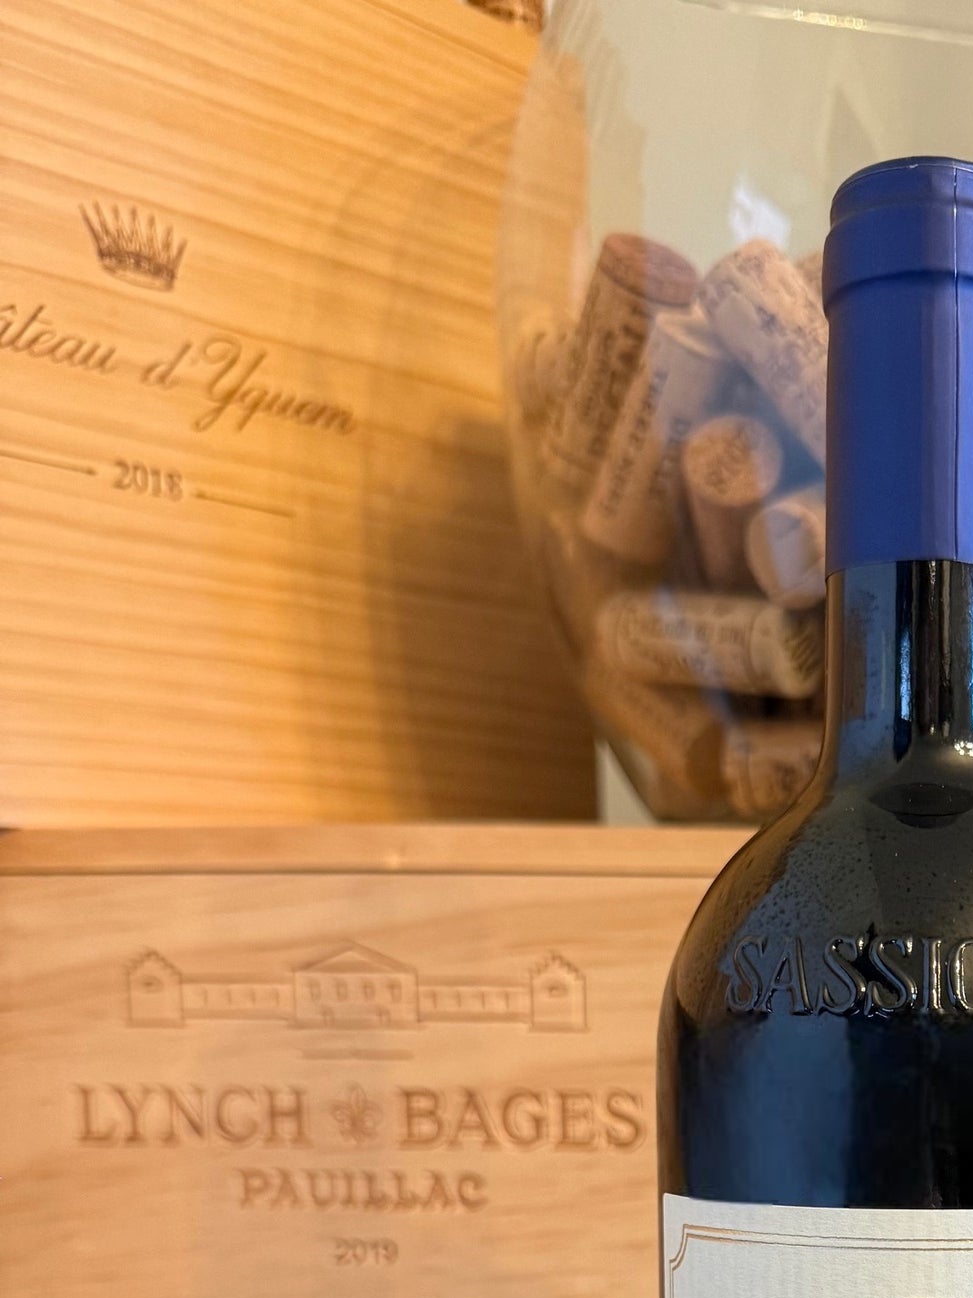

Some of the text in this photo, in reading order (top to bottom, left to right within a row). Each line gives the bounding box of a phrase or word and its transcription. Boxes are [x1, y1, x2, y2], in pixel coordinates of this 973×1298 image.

[112, 459, 184, 501] 2018
[74, 1084, 646, 1152] LYNCH BAGES
[236, 1167, 486, 1213] PAUILLAC
[333, 1236, 399, 1266] 2019
